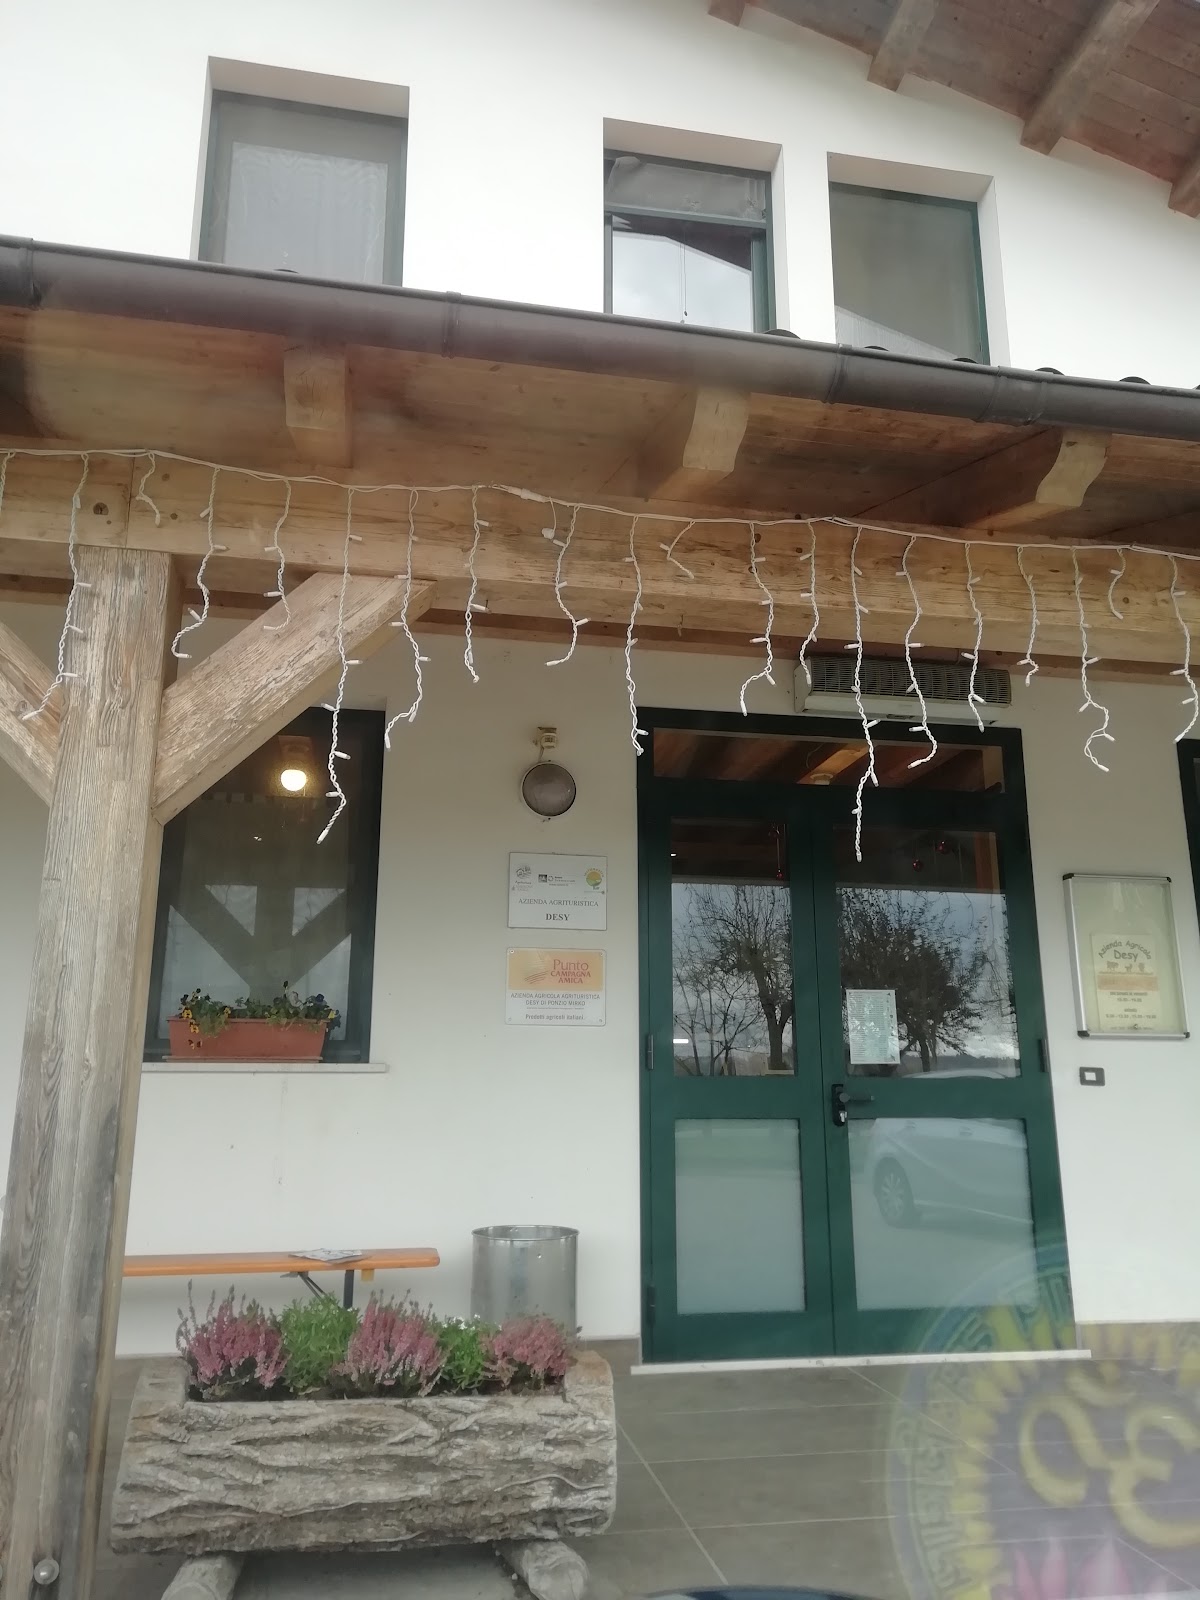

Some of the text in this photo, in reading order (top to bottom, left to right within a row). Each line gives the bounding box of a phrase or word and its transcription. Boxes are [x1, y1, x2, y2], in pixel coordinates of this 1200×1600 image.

[549, 899, 599, 907] AGRITURISTICA
[545, 913, 570, 921] DESY
[1098, 940, 1152, 960] Azienda Agricola
[1114, 949, 1139, 962] Desy
[553, 959, 589, 971] Punto
